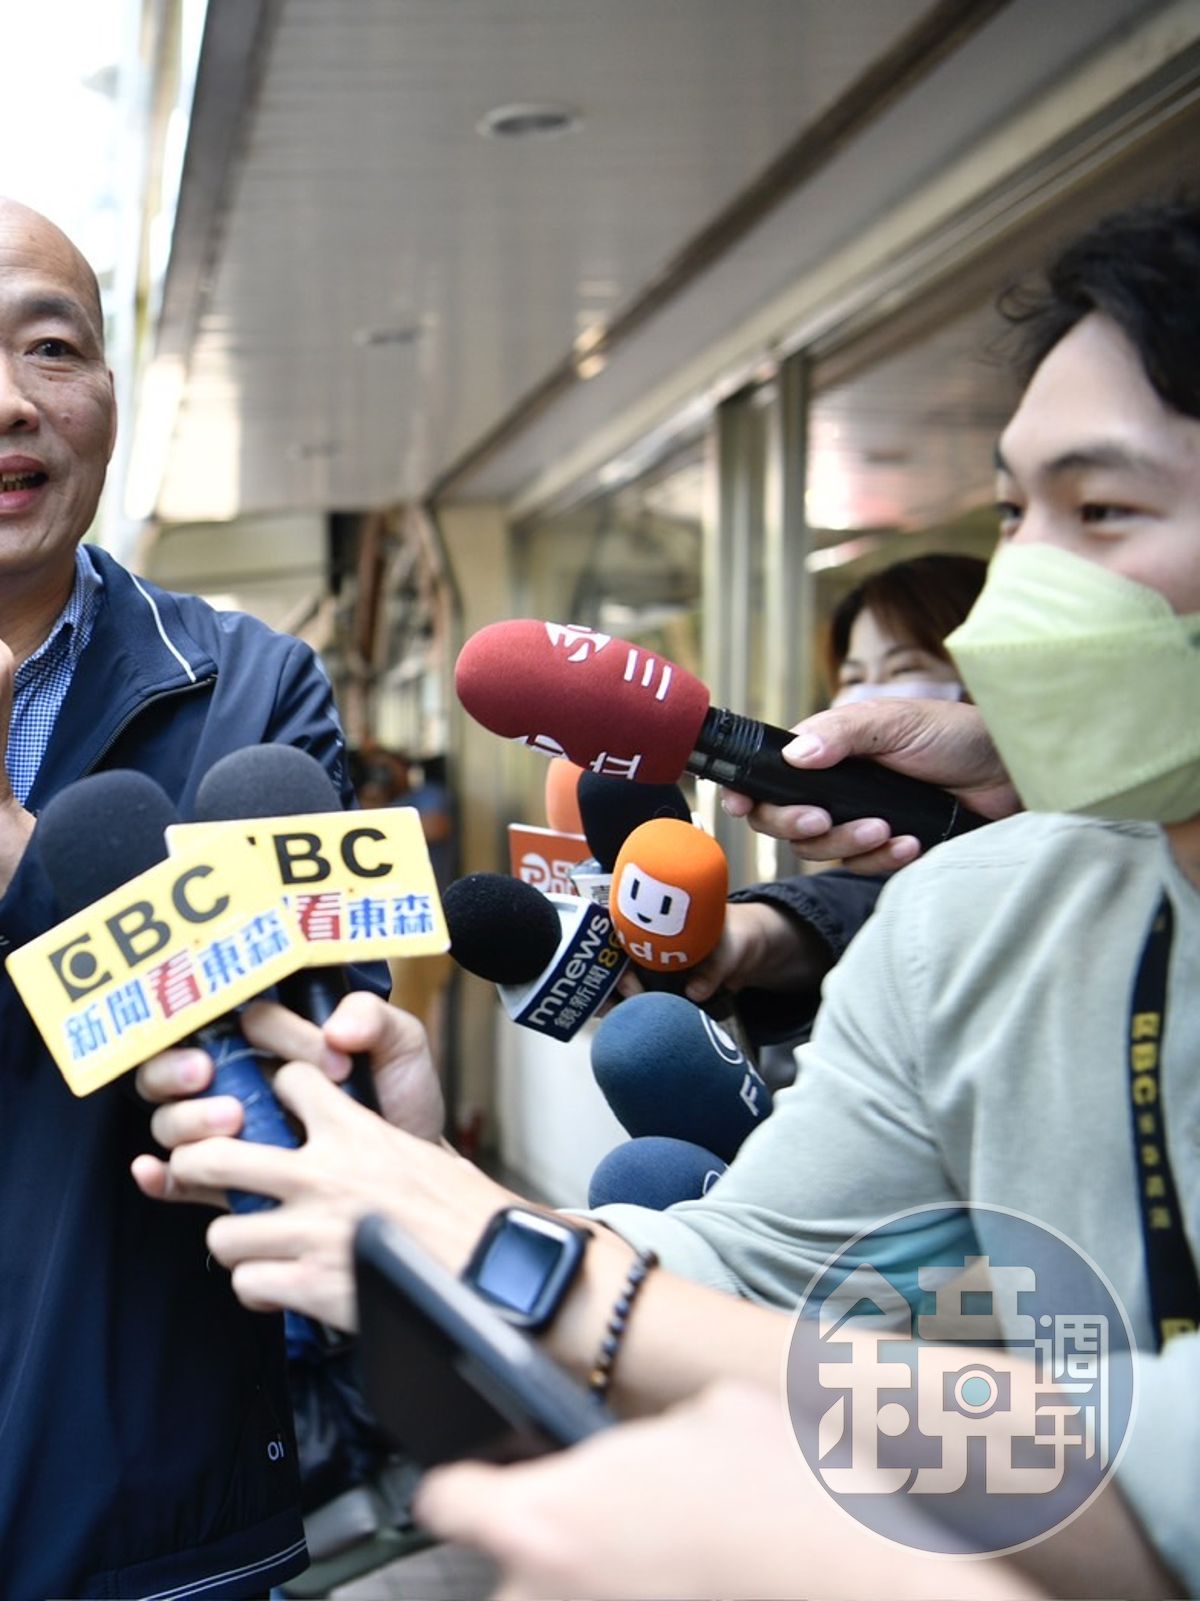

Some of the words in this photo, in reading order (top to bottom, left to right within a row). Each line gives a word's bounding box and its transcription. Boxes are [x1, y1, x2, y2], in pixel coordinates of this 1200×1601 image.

[247, 827, 394, 885] BC
[282, 890, 435, 943] 看東森
[64, 909, 292, 1061] 新聞看東森
[527, 915, 610, 1026] mnews
